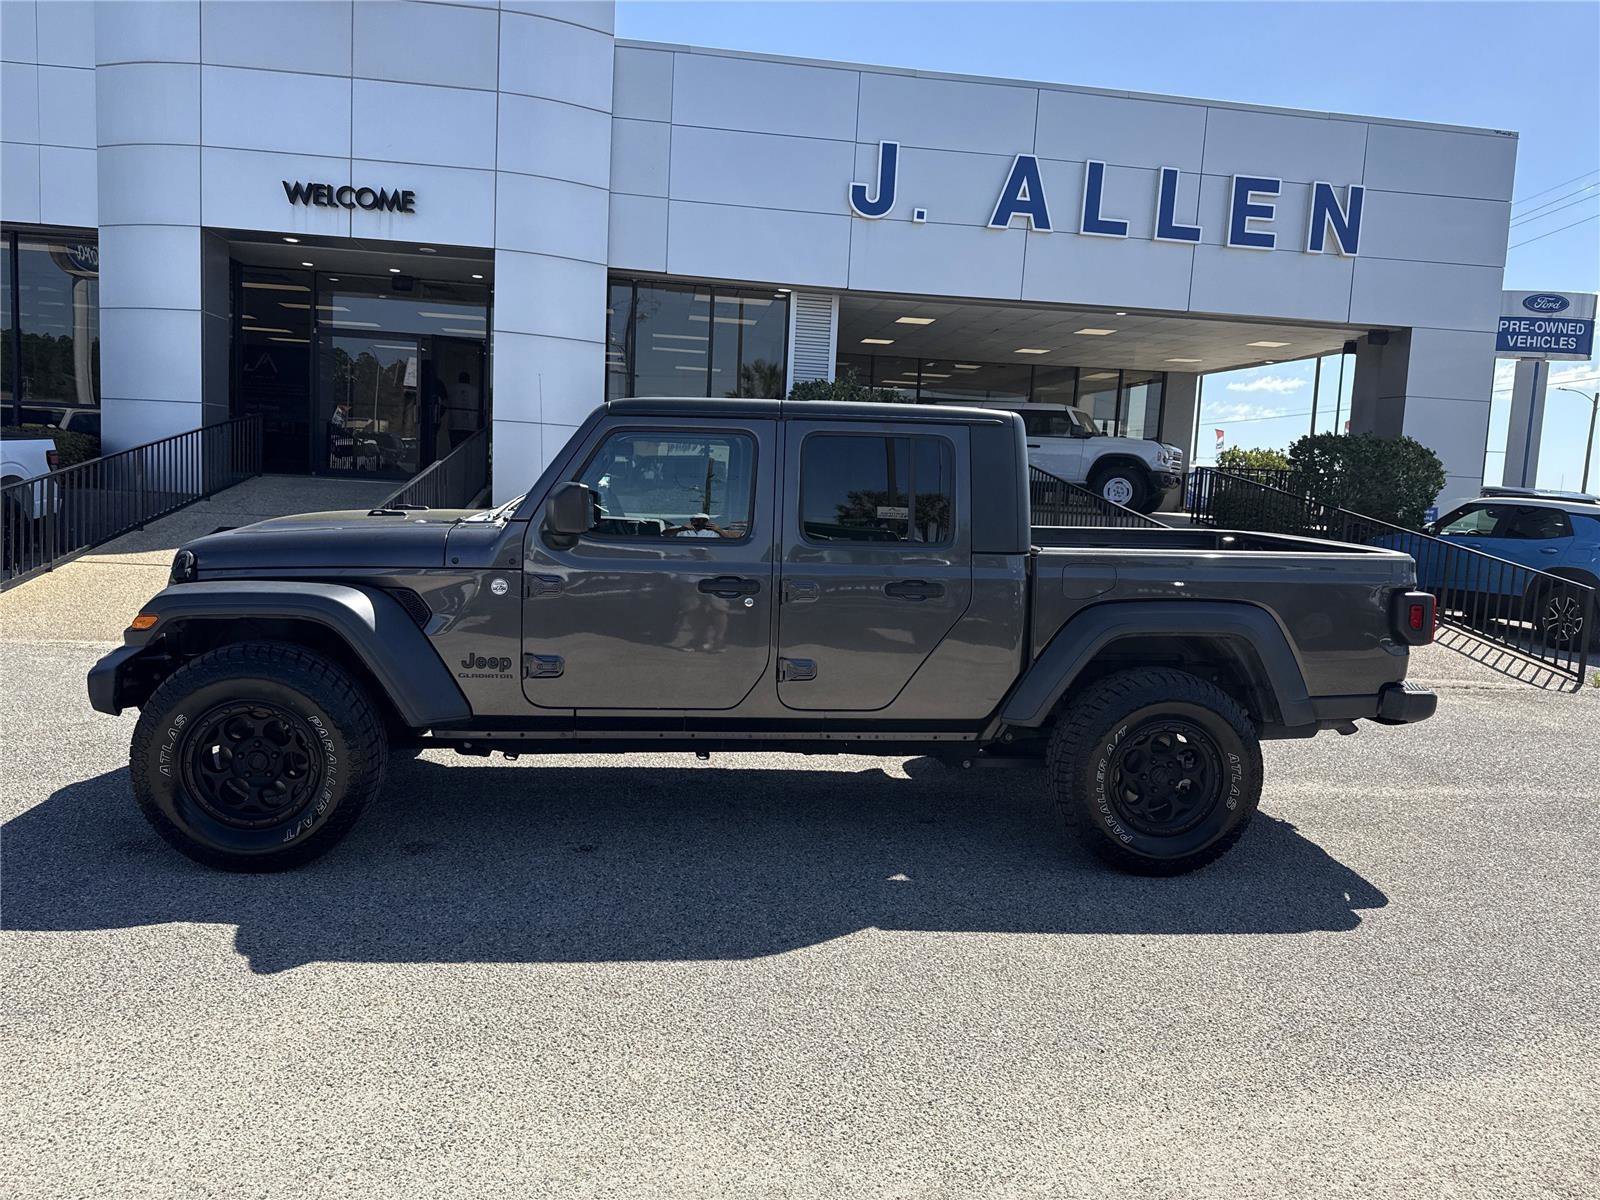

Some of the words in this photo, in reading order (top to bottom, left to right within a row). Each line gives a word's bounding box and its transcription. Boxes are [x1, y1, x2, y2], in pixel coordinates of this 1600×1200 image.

[282, 180, 416, 213] WELCOME
[849, 140, 927, 223] J.
[987, 153, 1365, 257] ALLEN
[1534, 296, 1562, 310] Ford
[1499, 320, 1585, 335] PRE-OWNED
[1507, 335, 1577, 349] VEHICLES
[461, 652, 513, 673] Jeep
[159, 714, 188, 777] ATLAS
[1106, 724, 1128, 756] A/T
[307, 715, 337, 815] PARALLER
[1225, 752, 1242, 810] ATLAS
[1096, 758, 1133, 844] PARALLER
[283, 815, 313, 843] A/T
